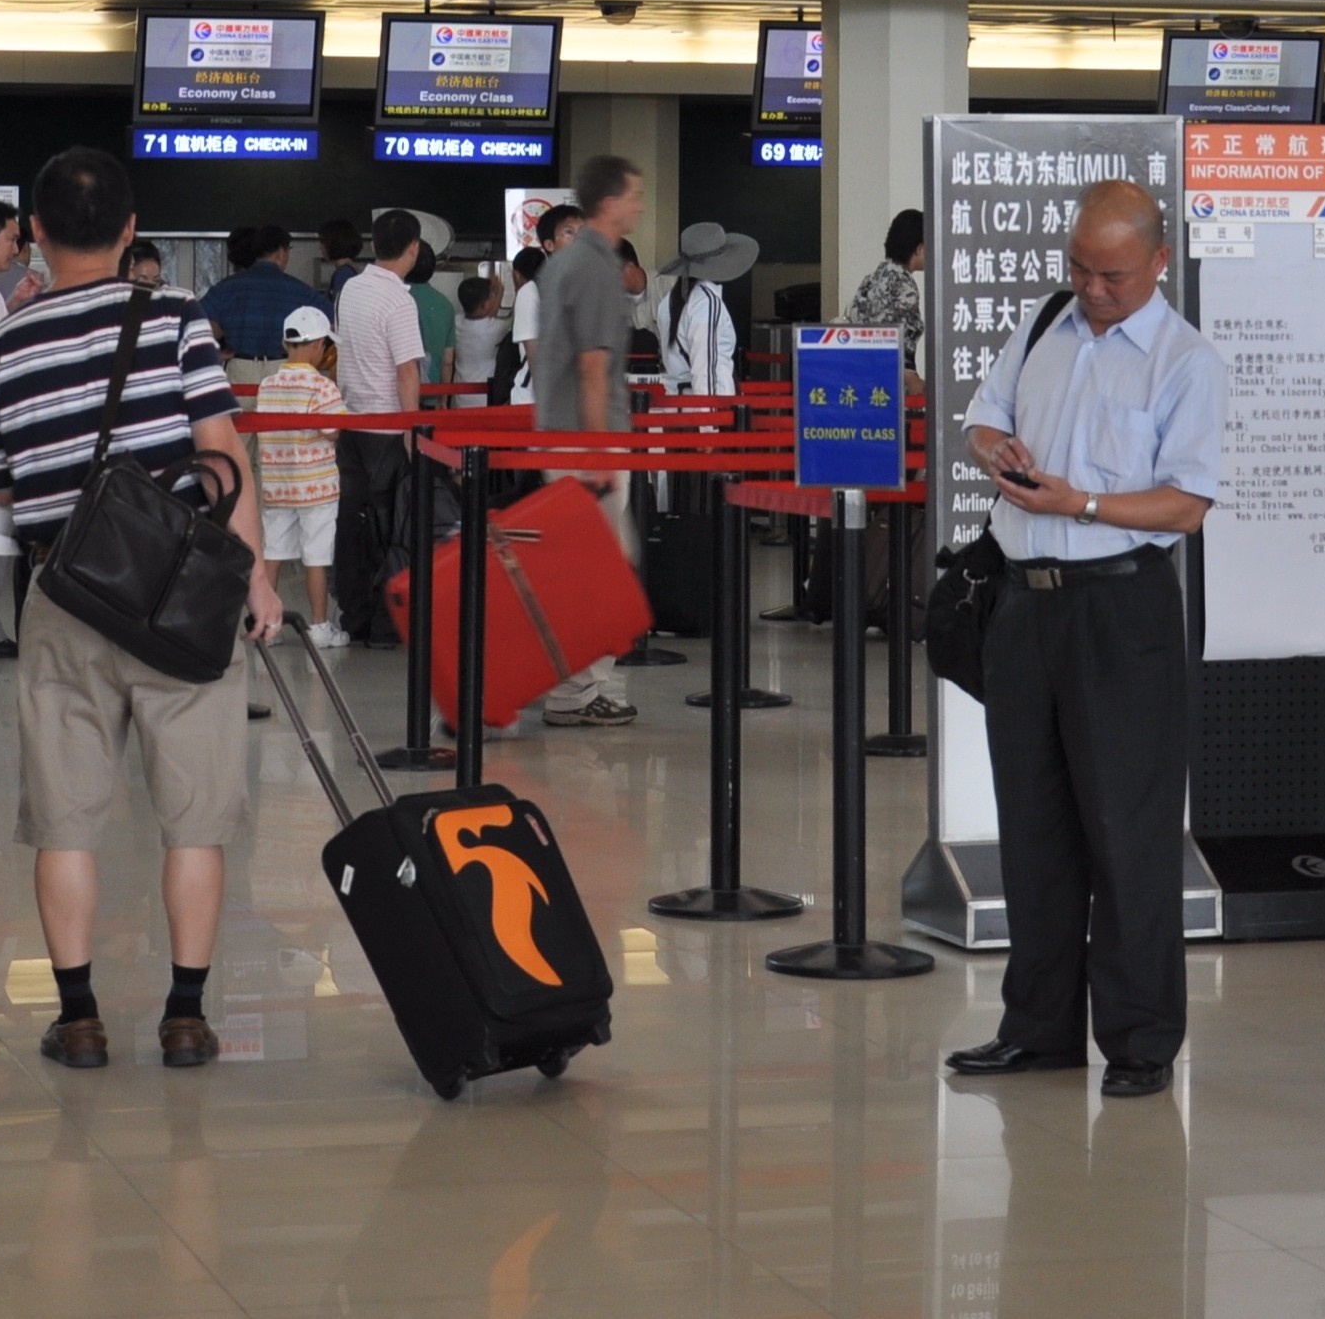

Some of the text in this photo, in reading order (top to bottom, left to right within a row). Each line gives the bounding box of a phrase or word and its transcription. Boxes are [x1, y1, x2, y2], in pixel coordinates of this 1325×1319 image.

[178, 87, 276, 101] Economy Class
[419, 90, 514, 105] Economy Class
[1189, 104, 1290, 113] Economy Class/Called flight
[144, 134, 307, 153] 71 值机柜台 CHECK-IN
[385, 137, 542, 157] 70 值机柜台 CHECK-IN
[761, 143, 822, 161] 69 值机
[1191, 165, 1298, 179] INFORMATION
[1302, 166, 1324, 180] OF
[1219, 209, 1290, 217] CHINA EASTERN
[1192, 226, 1252, 240] 航班号
[1212, 332, 1294, 342] Dear Passengers:
[1234, 377, 1265, 386] Thanks
[1270, 377, 1285, 386] for
[1292, 377, 1322, 387] taking
[1229, 387, 1258, 397] lines.
[1265, 387, 1276, 397] We
[804, 428, 896, 440] ECONOMY CLASS
[1235, 433, 1244, 442] If
[1250, 434, 1266, 443] you
[1271, 433, 1292, 443] only
[1297, 433, 1318, 441] have
[1235, 444, 1256, 454] Auto
[1260, 444, 1303, 453] Check-in
[1235, 489, 1272, 498] Welcome
[1277, 489, 1288, 498] to
[1292, 489, 1308, 498] use
[1214, 500, 1295, 510] Check-in System.
[1235, 512, 1251, 521] Web
[1257, 512, 1280, 521] site:
